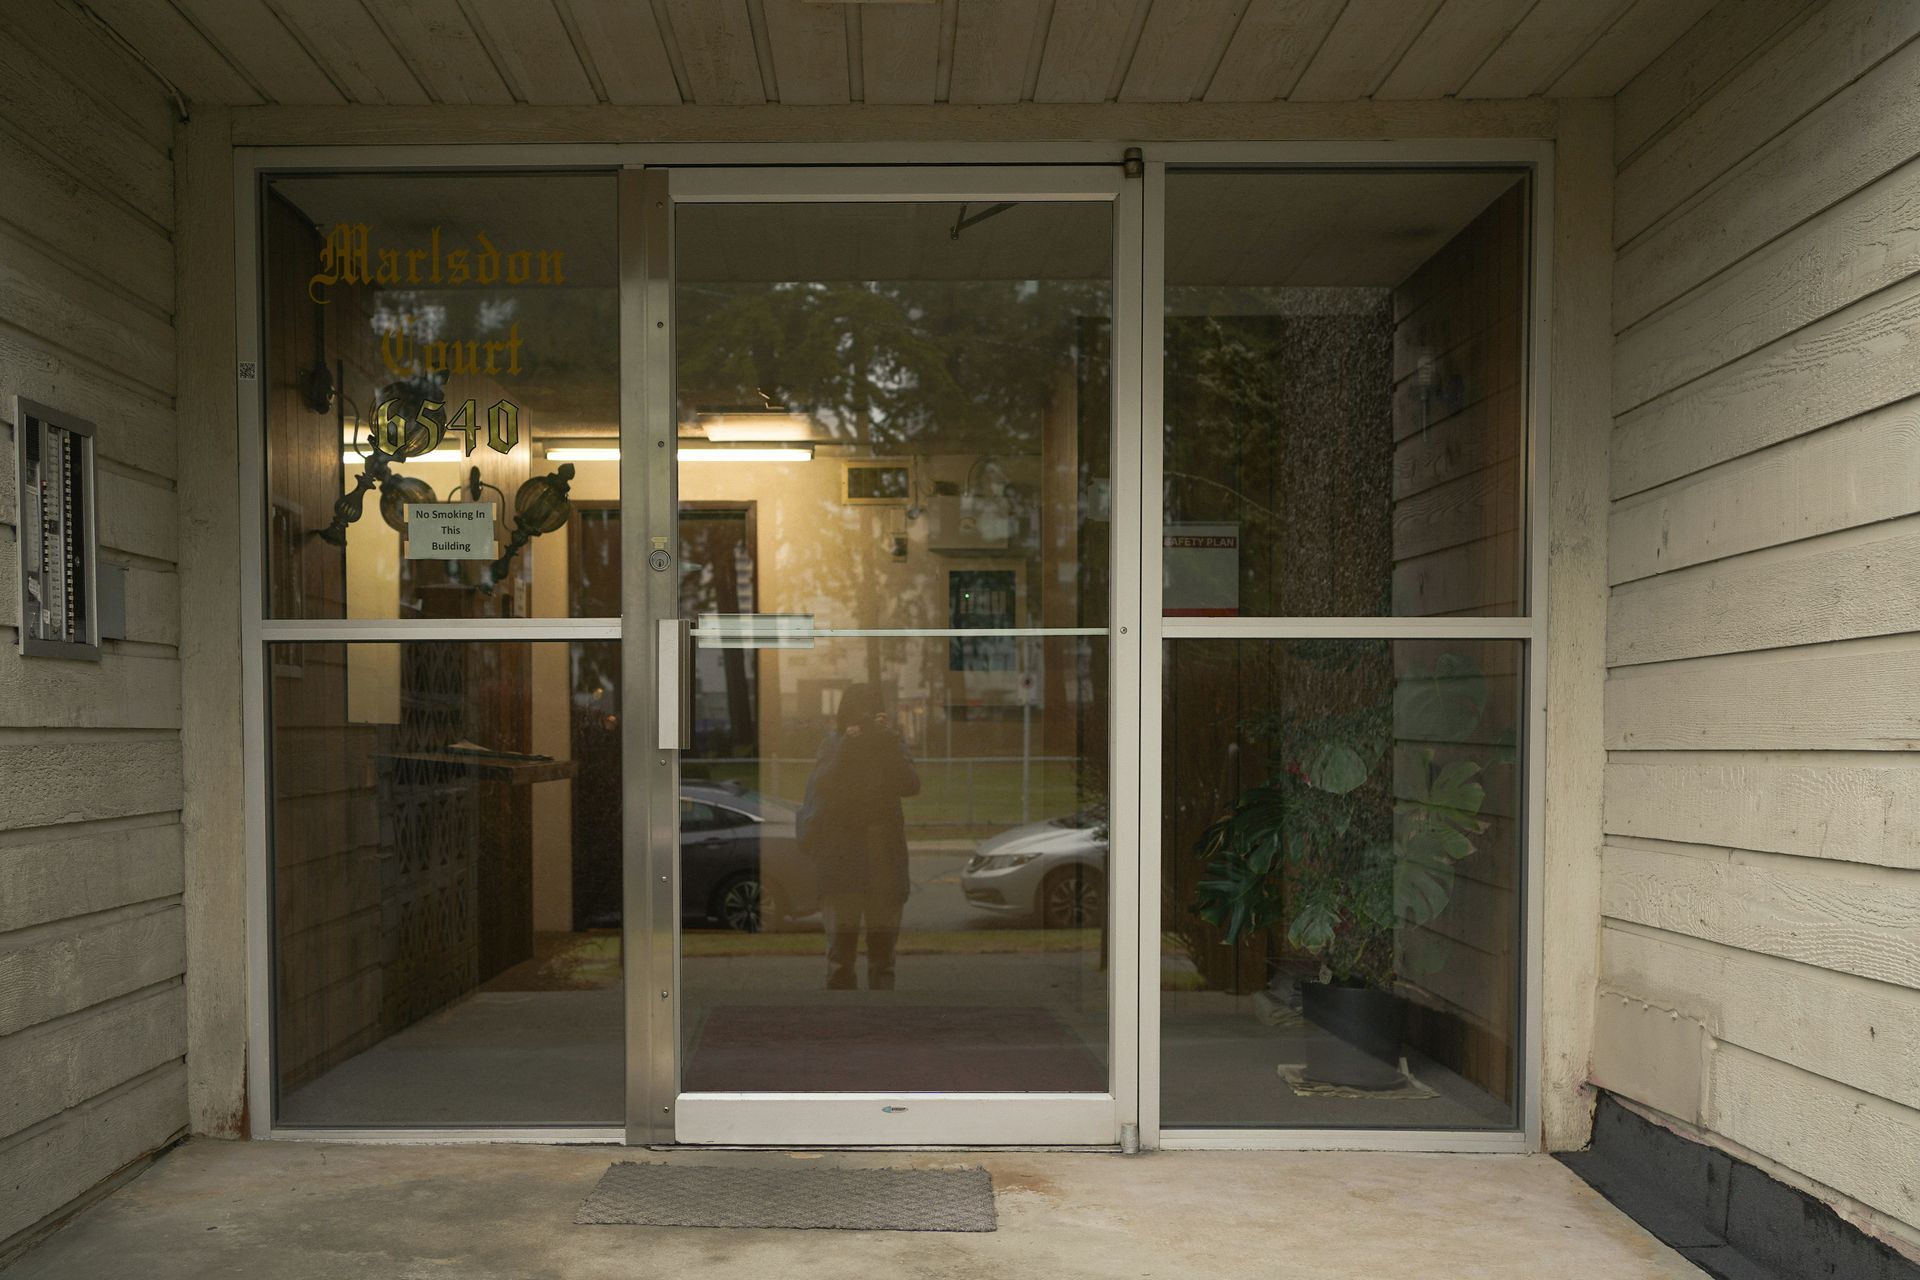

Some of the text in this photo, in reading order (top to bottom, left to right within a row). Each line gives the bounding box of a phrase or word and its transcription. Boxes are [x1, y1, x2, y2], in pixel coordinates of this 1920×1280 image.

[308, 223, 566, 304] Marlsdon
[378, 313, 524, 377] Court
[377, 398, 519, 457] 6540
[416, 510, 485, 520] No Smoking In
[441, 526, 461, 535] This
[432, 542, 471, 552] Building
[1206, 537, 1235, 547] PLAN
